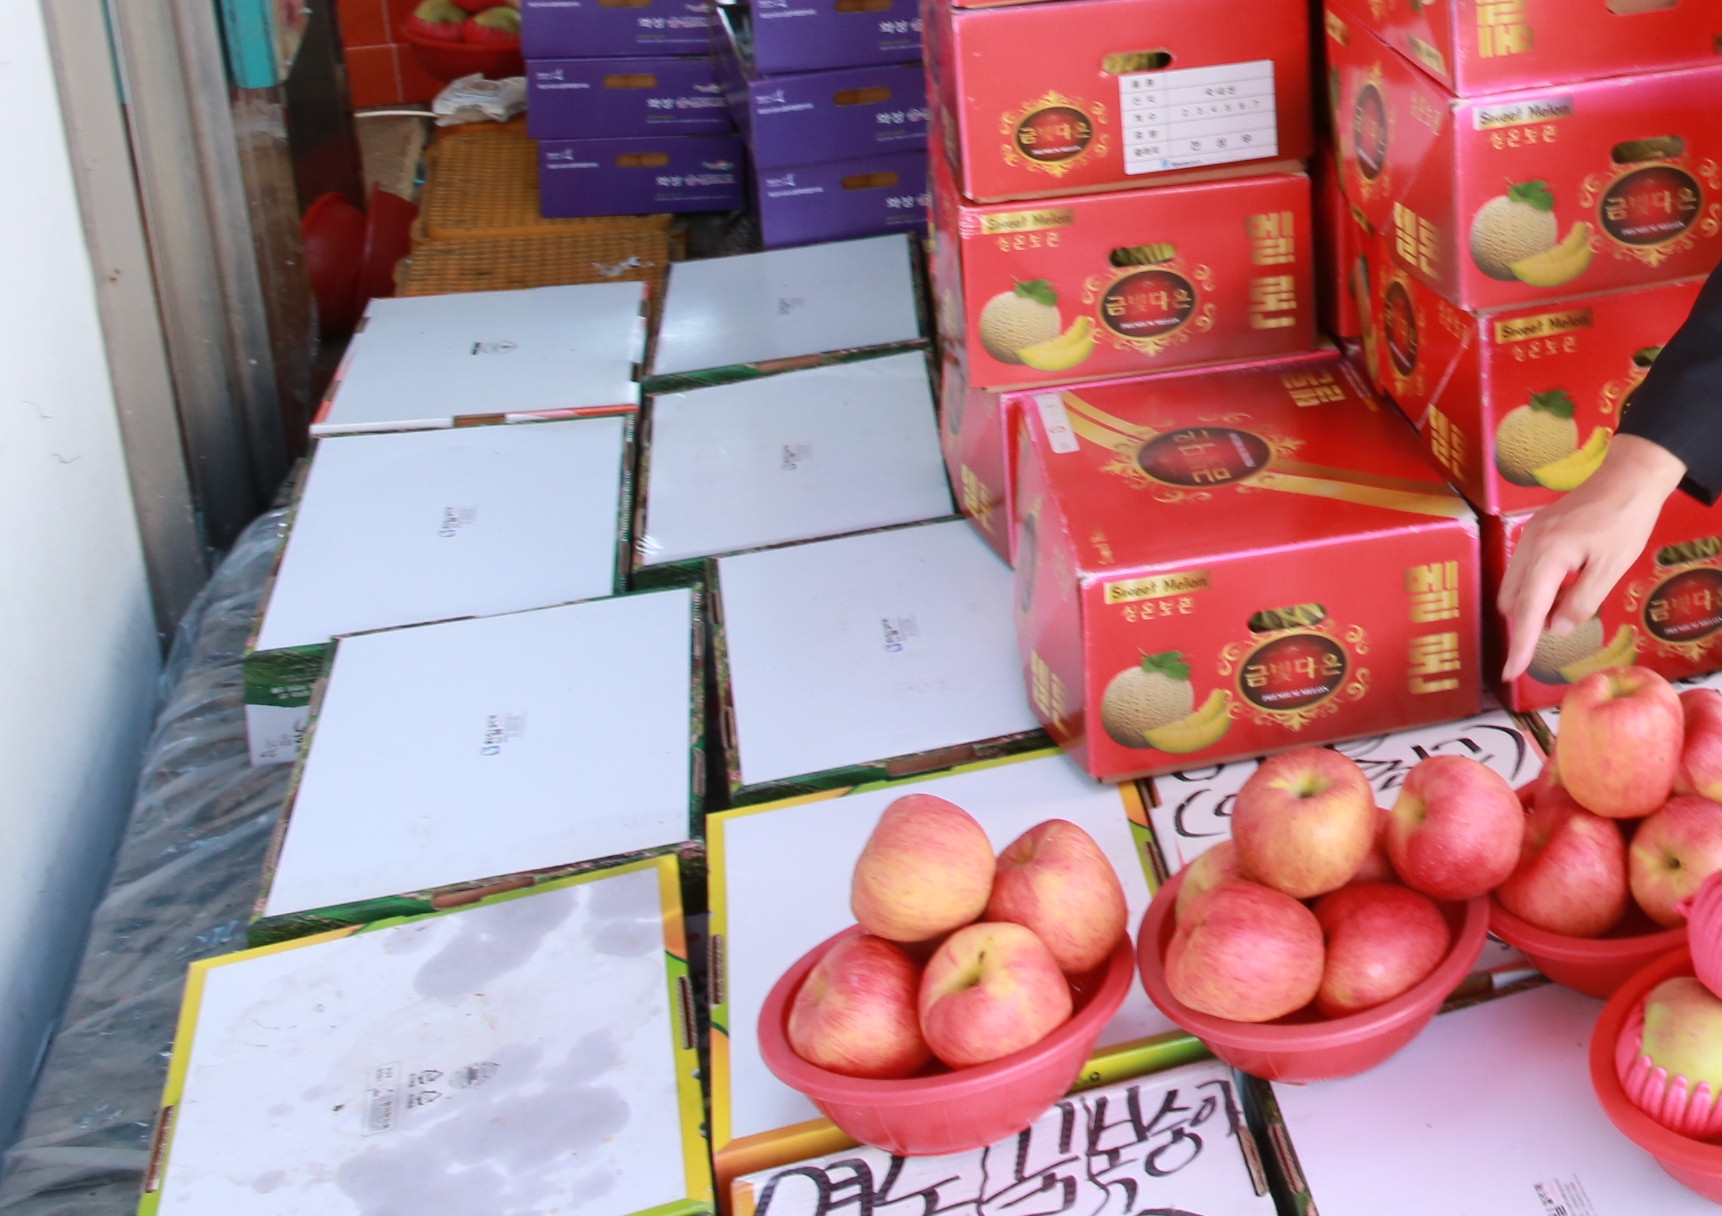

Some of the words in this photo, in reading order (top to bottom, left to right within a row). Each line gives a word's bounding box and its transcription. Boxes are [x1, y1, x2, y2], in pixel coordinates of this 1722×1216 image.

[1245, 211, 1297, 330] 멜론
[1500, 321, 1544, 340] Sweet
[1111, 581, 1157, 600] Sweet
[1163, 575, 1208, 593] Melon
[1403, 560, 1461, 695] 멜론
